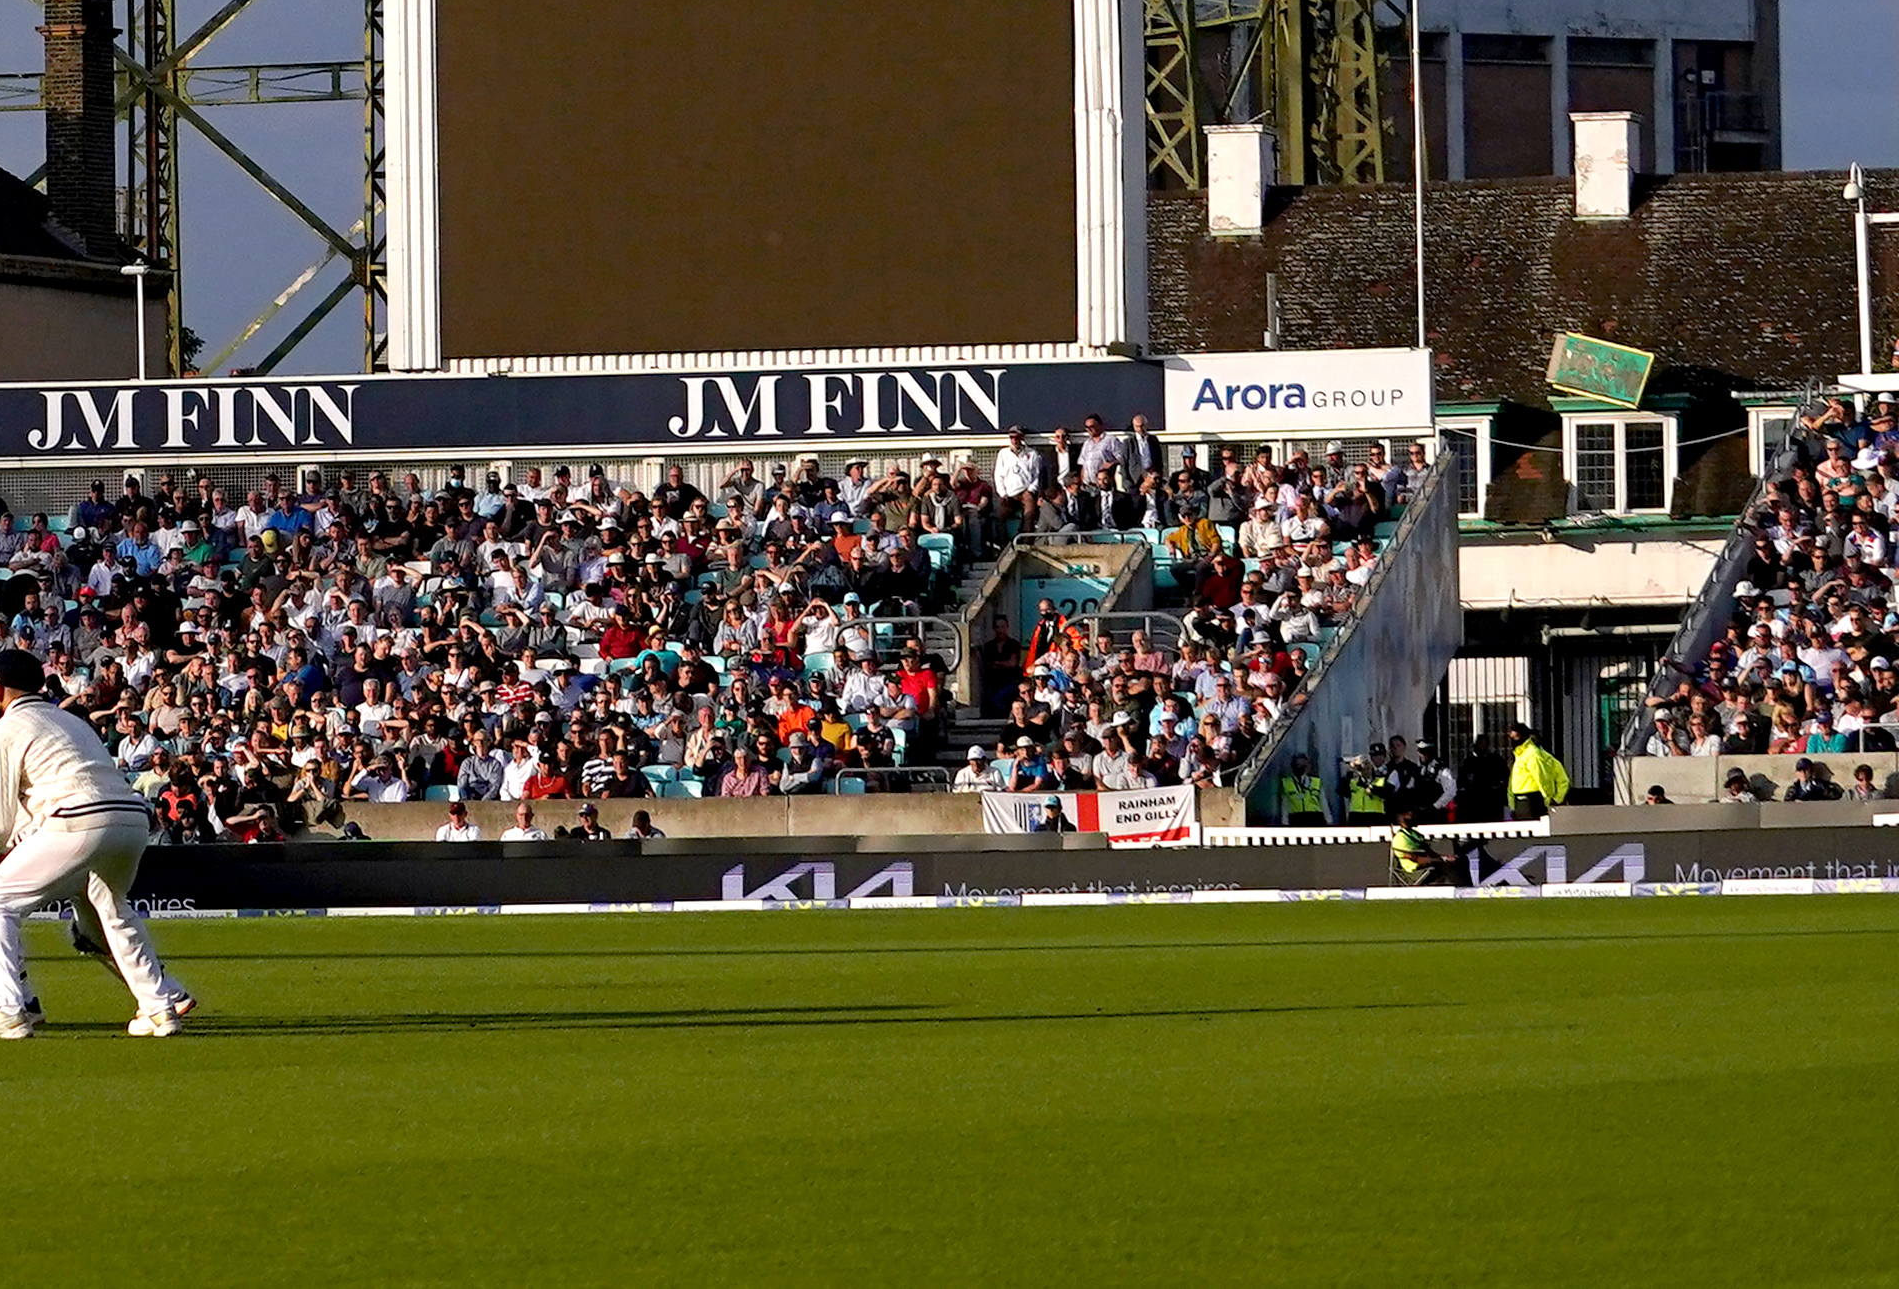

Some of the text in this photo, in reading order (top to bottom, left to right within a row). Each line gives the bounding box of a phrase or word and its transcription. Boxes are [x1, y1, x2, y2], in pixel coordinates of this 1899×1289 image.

[666, 368, 1008, 439] JM FINN
[1192, 377, 1405, 412] Arora GROUP
[27, 384, 361, 451] JM FINN
[1116, 809, 1180, 824] END GILLS
[1118, 795, 1177, 810] RAINHAM
[721, 860, 914, 900] KIA
[944, 881, 1079, 897] Movement
[1674, 859, 1816, 883] Movement
[1824, 857, 1878, 880] that
